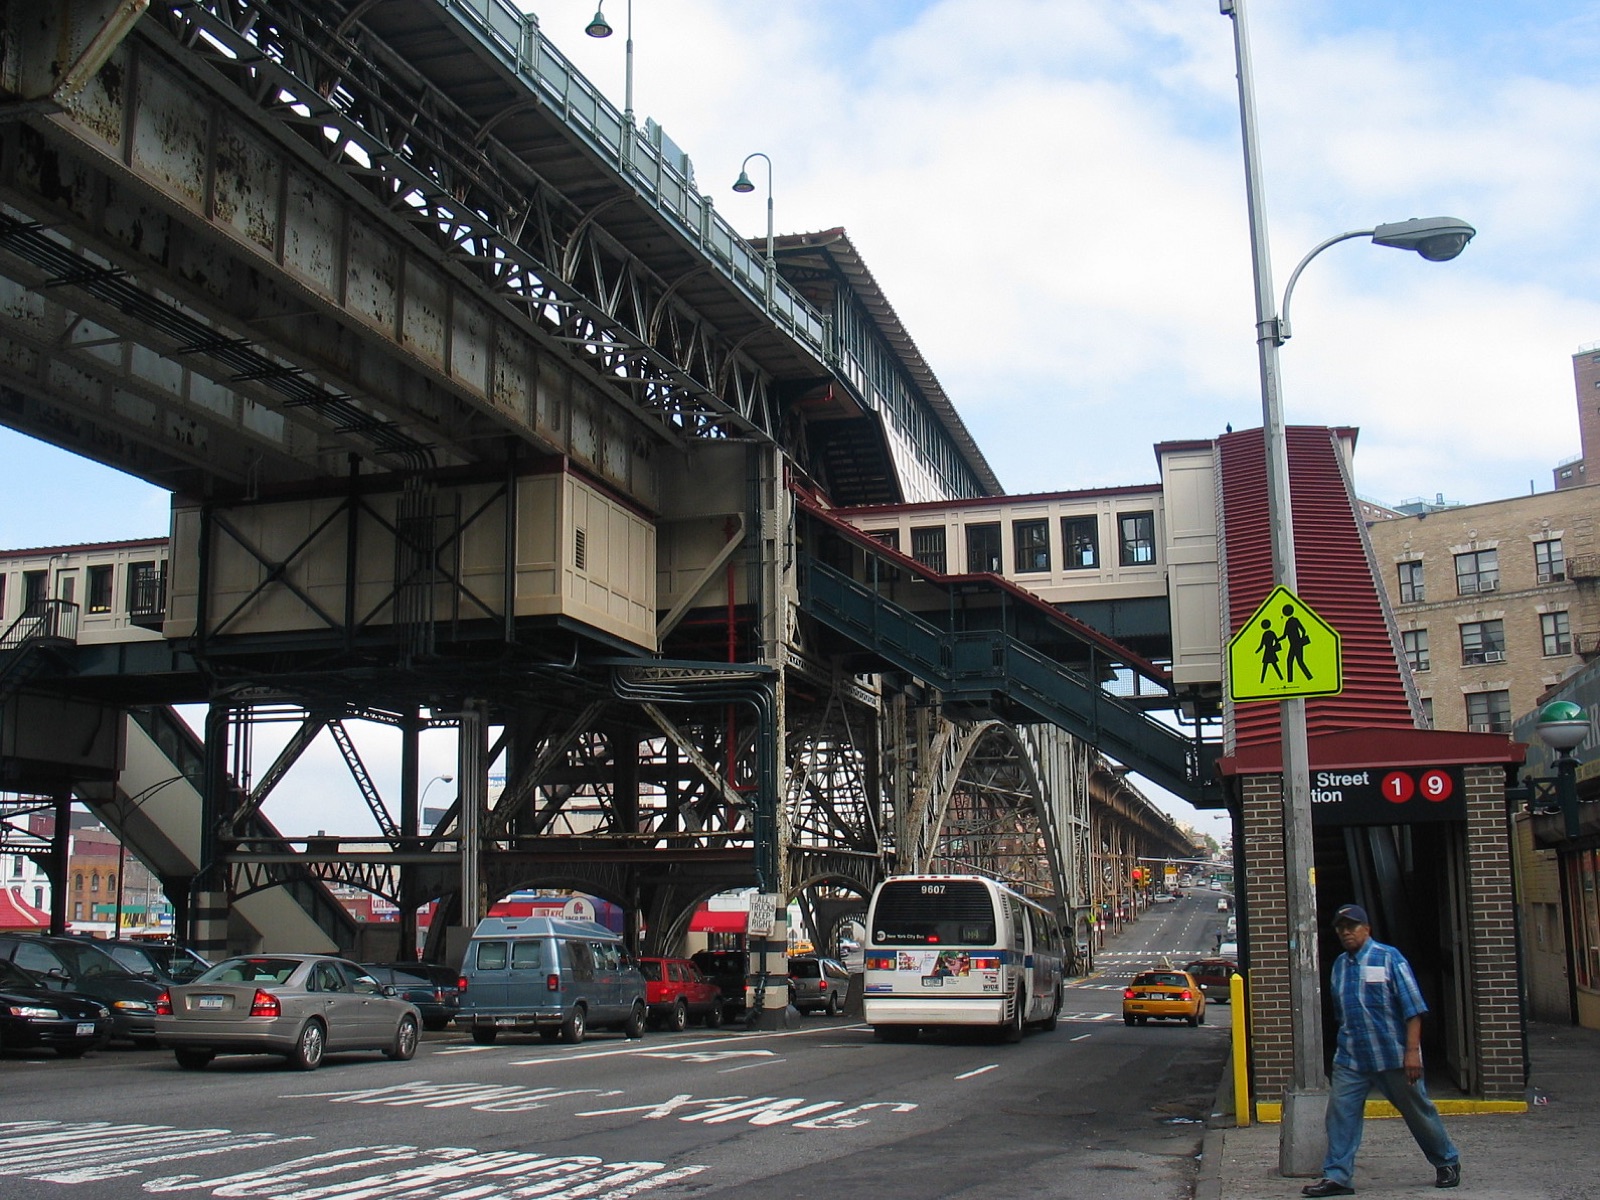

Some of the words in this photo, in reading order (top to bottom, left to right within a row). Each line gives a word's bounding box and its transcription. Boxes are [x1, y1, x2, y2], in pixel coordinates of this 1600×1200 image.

[1316, 771, 1370, 788] Street
[1391, 777, 1402, 796] 1
[1427, 775, 1444, 795] 9
[1310, 788, 1343, 804] tion
[921, 885, 946, 895] 9607
[757, 896, 769, 905] ALL
[751, 902, 776, 913] TRUCKS
[753, 911, 771, 920] KEEP
[751, 919, 772, 929] RIGHT
[278, 1080, 626, 1113] XING
[574, 1094, 920, 1130] XING
